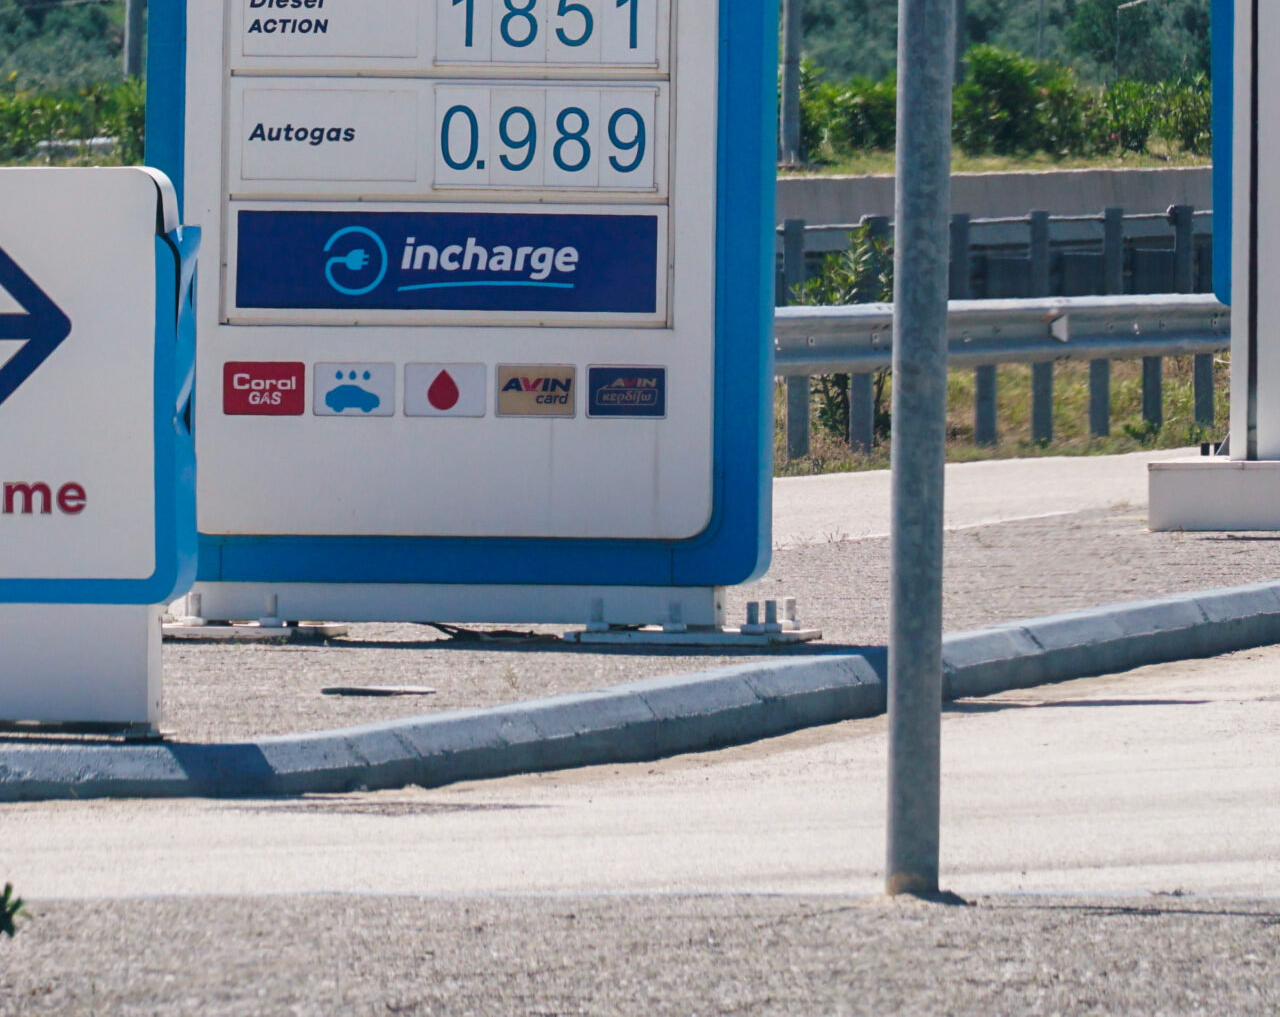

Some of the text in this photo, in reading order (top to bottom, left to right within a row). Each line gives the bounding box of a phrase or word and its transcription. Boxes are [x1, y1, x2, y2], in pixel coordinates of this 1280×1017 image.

[248, 18, 329, 34] ACTION
[248, 123, 357, 146] Autogas
[440, 104, 646, 174] 0.989
[401, 236, 579, 280] incharge
[232, 373, 297, 390] Coral
[501, 377, 572, 392] AVIN
[611, 377, 657, 388] AVIN
[248, 391, 282, 405] GAS
[535, 392, 569, 405] card
